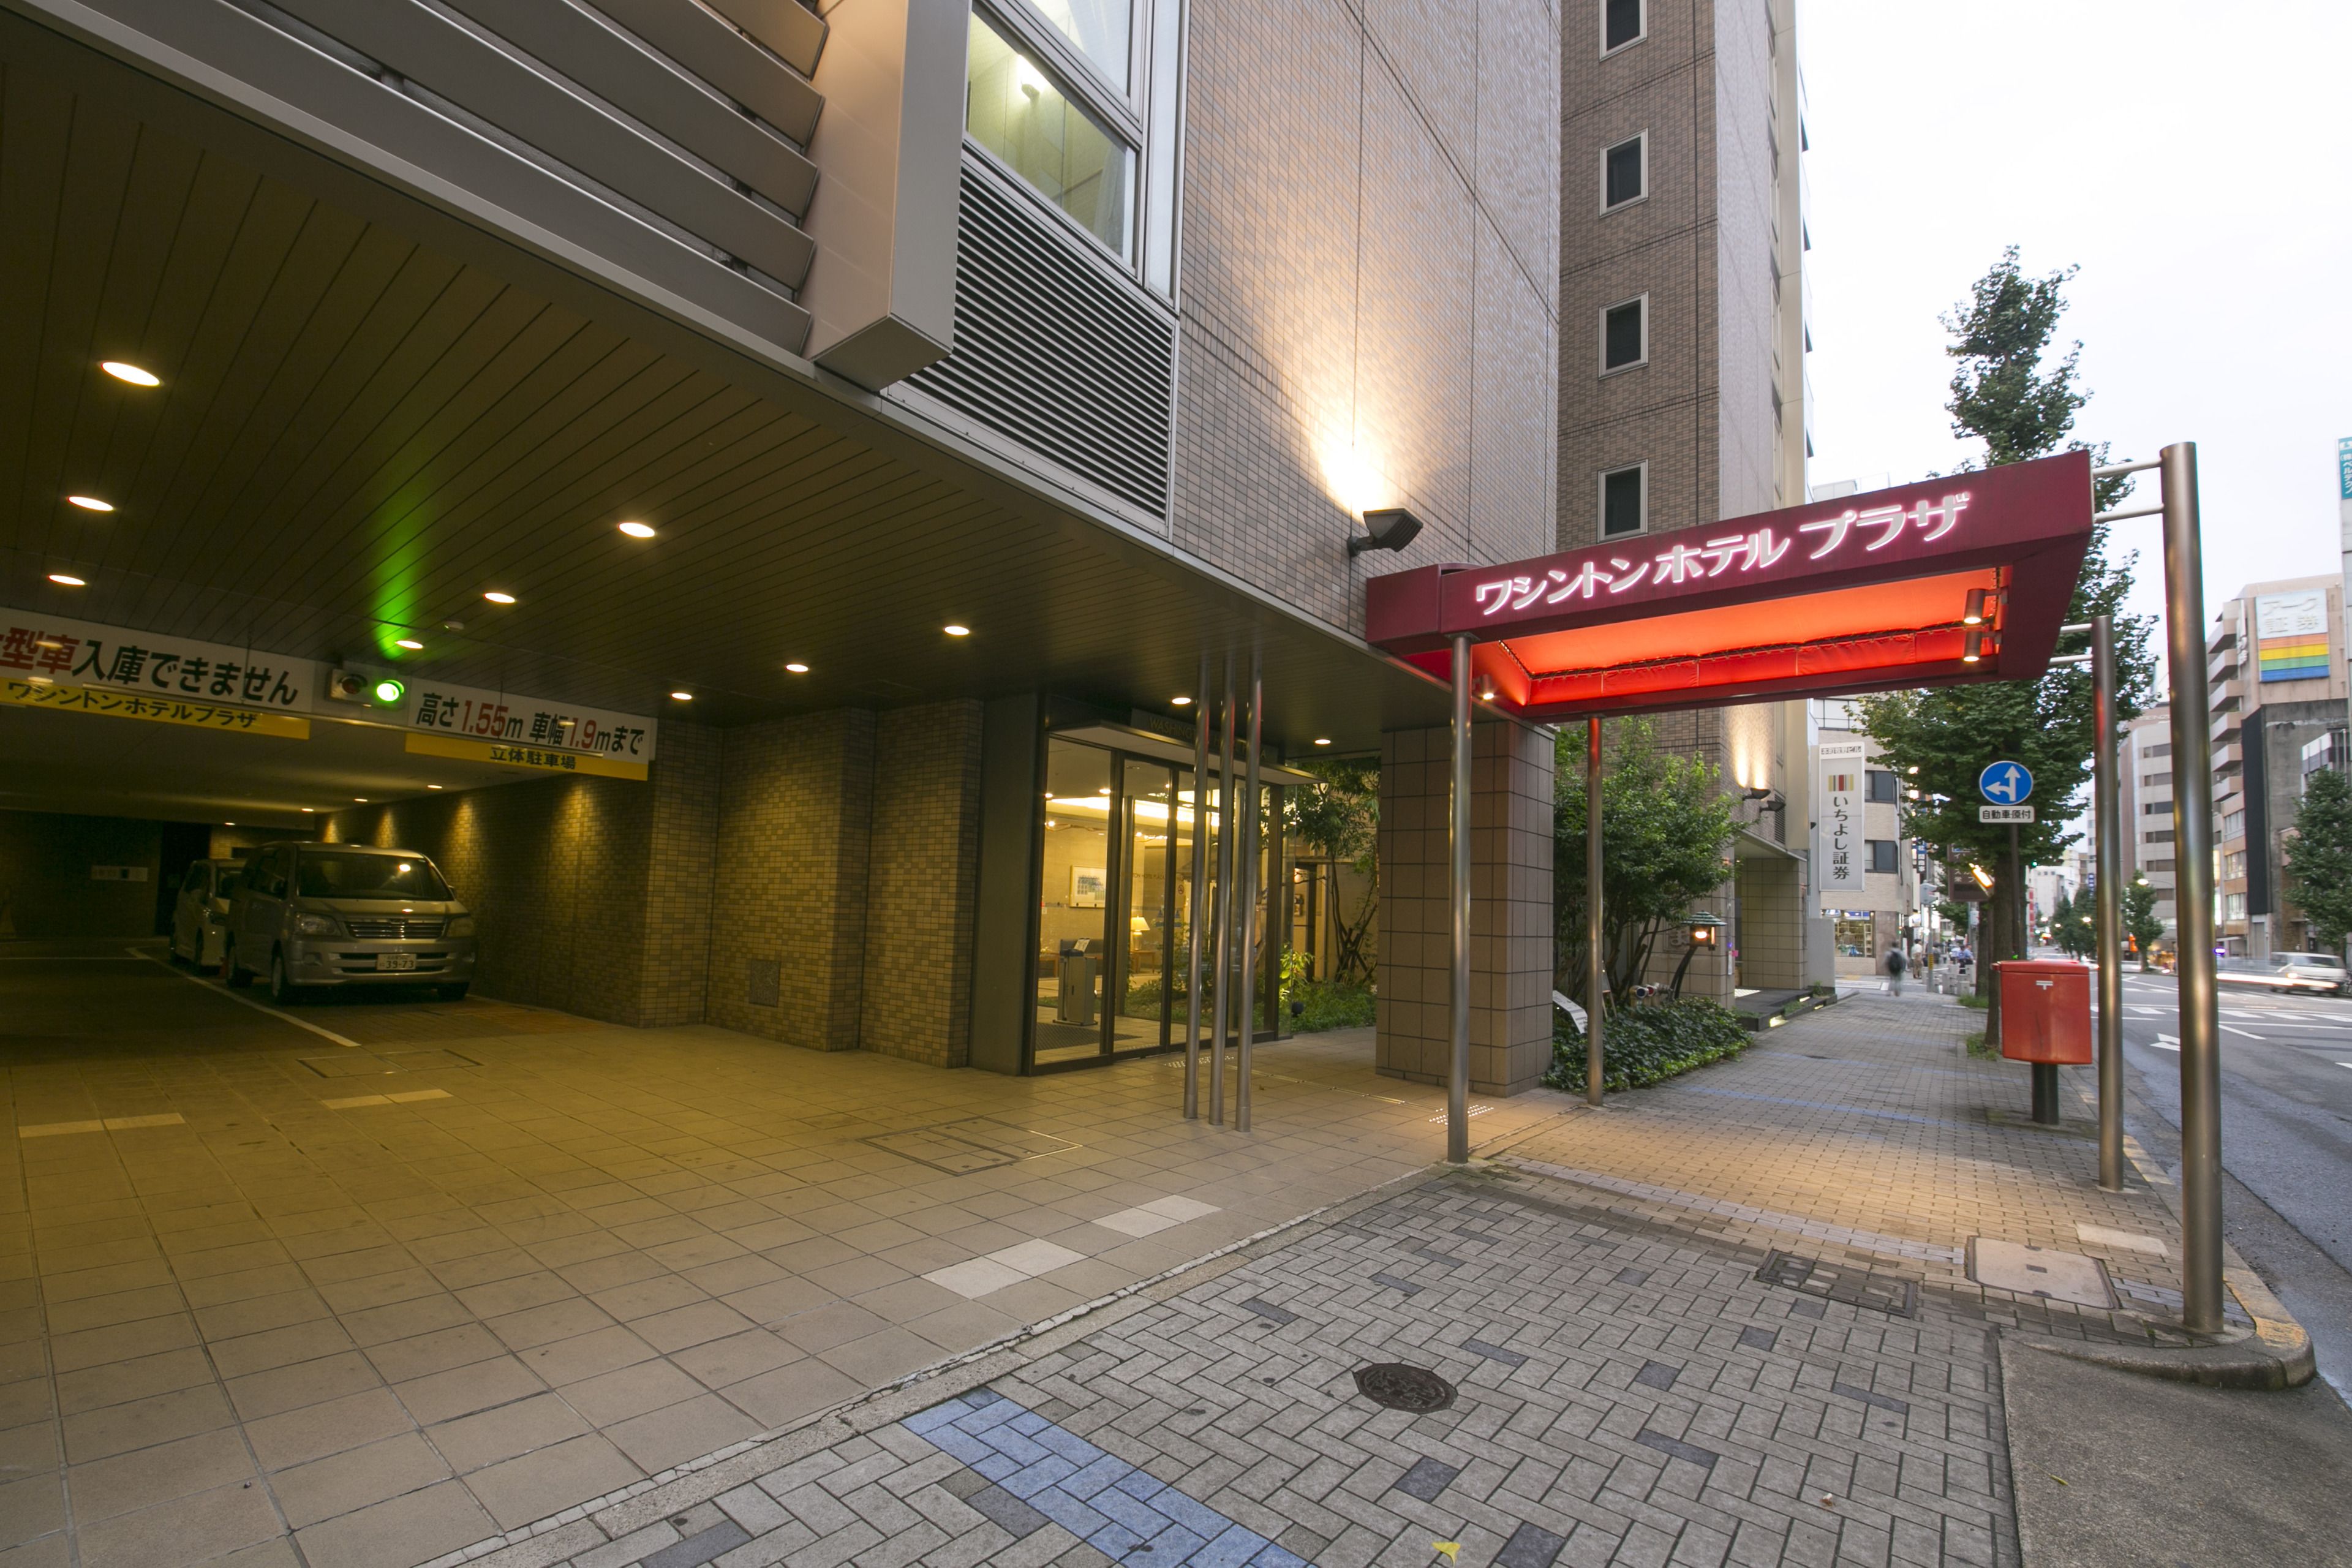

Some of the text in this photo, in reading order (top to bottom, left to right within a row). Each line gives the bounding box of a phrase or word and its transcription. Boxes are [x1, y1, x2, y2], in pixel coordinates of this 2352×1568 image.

[0, 627, 298, 706] 型車入庫できません
[8, 681, 257, 728] ワシントンホテルプラザ
[490, 747, 576, 770] 立体駐車場
[1833, 796, 1850, 880] いちよし証券
[386, 960, 414, 968] 39-73
